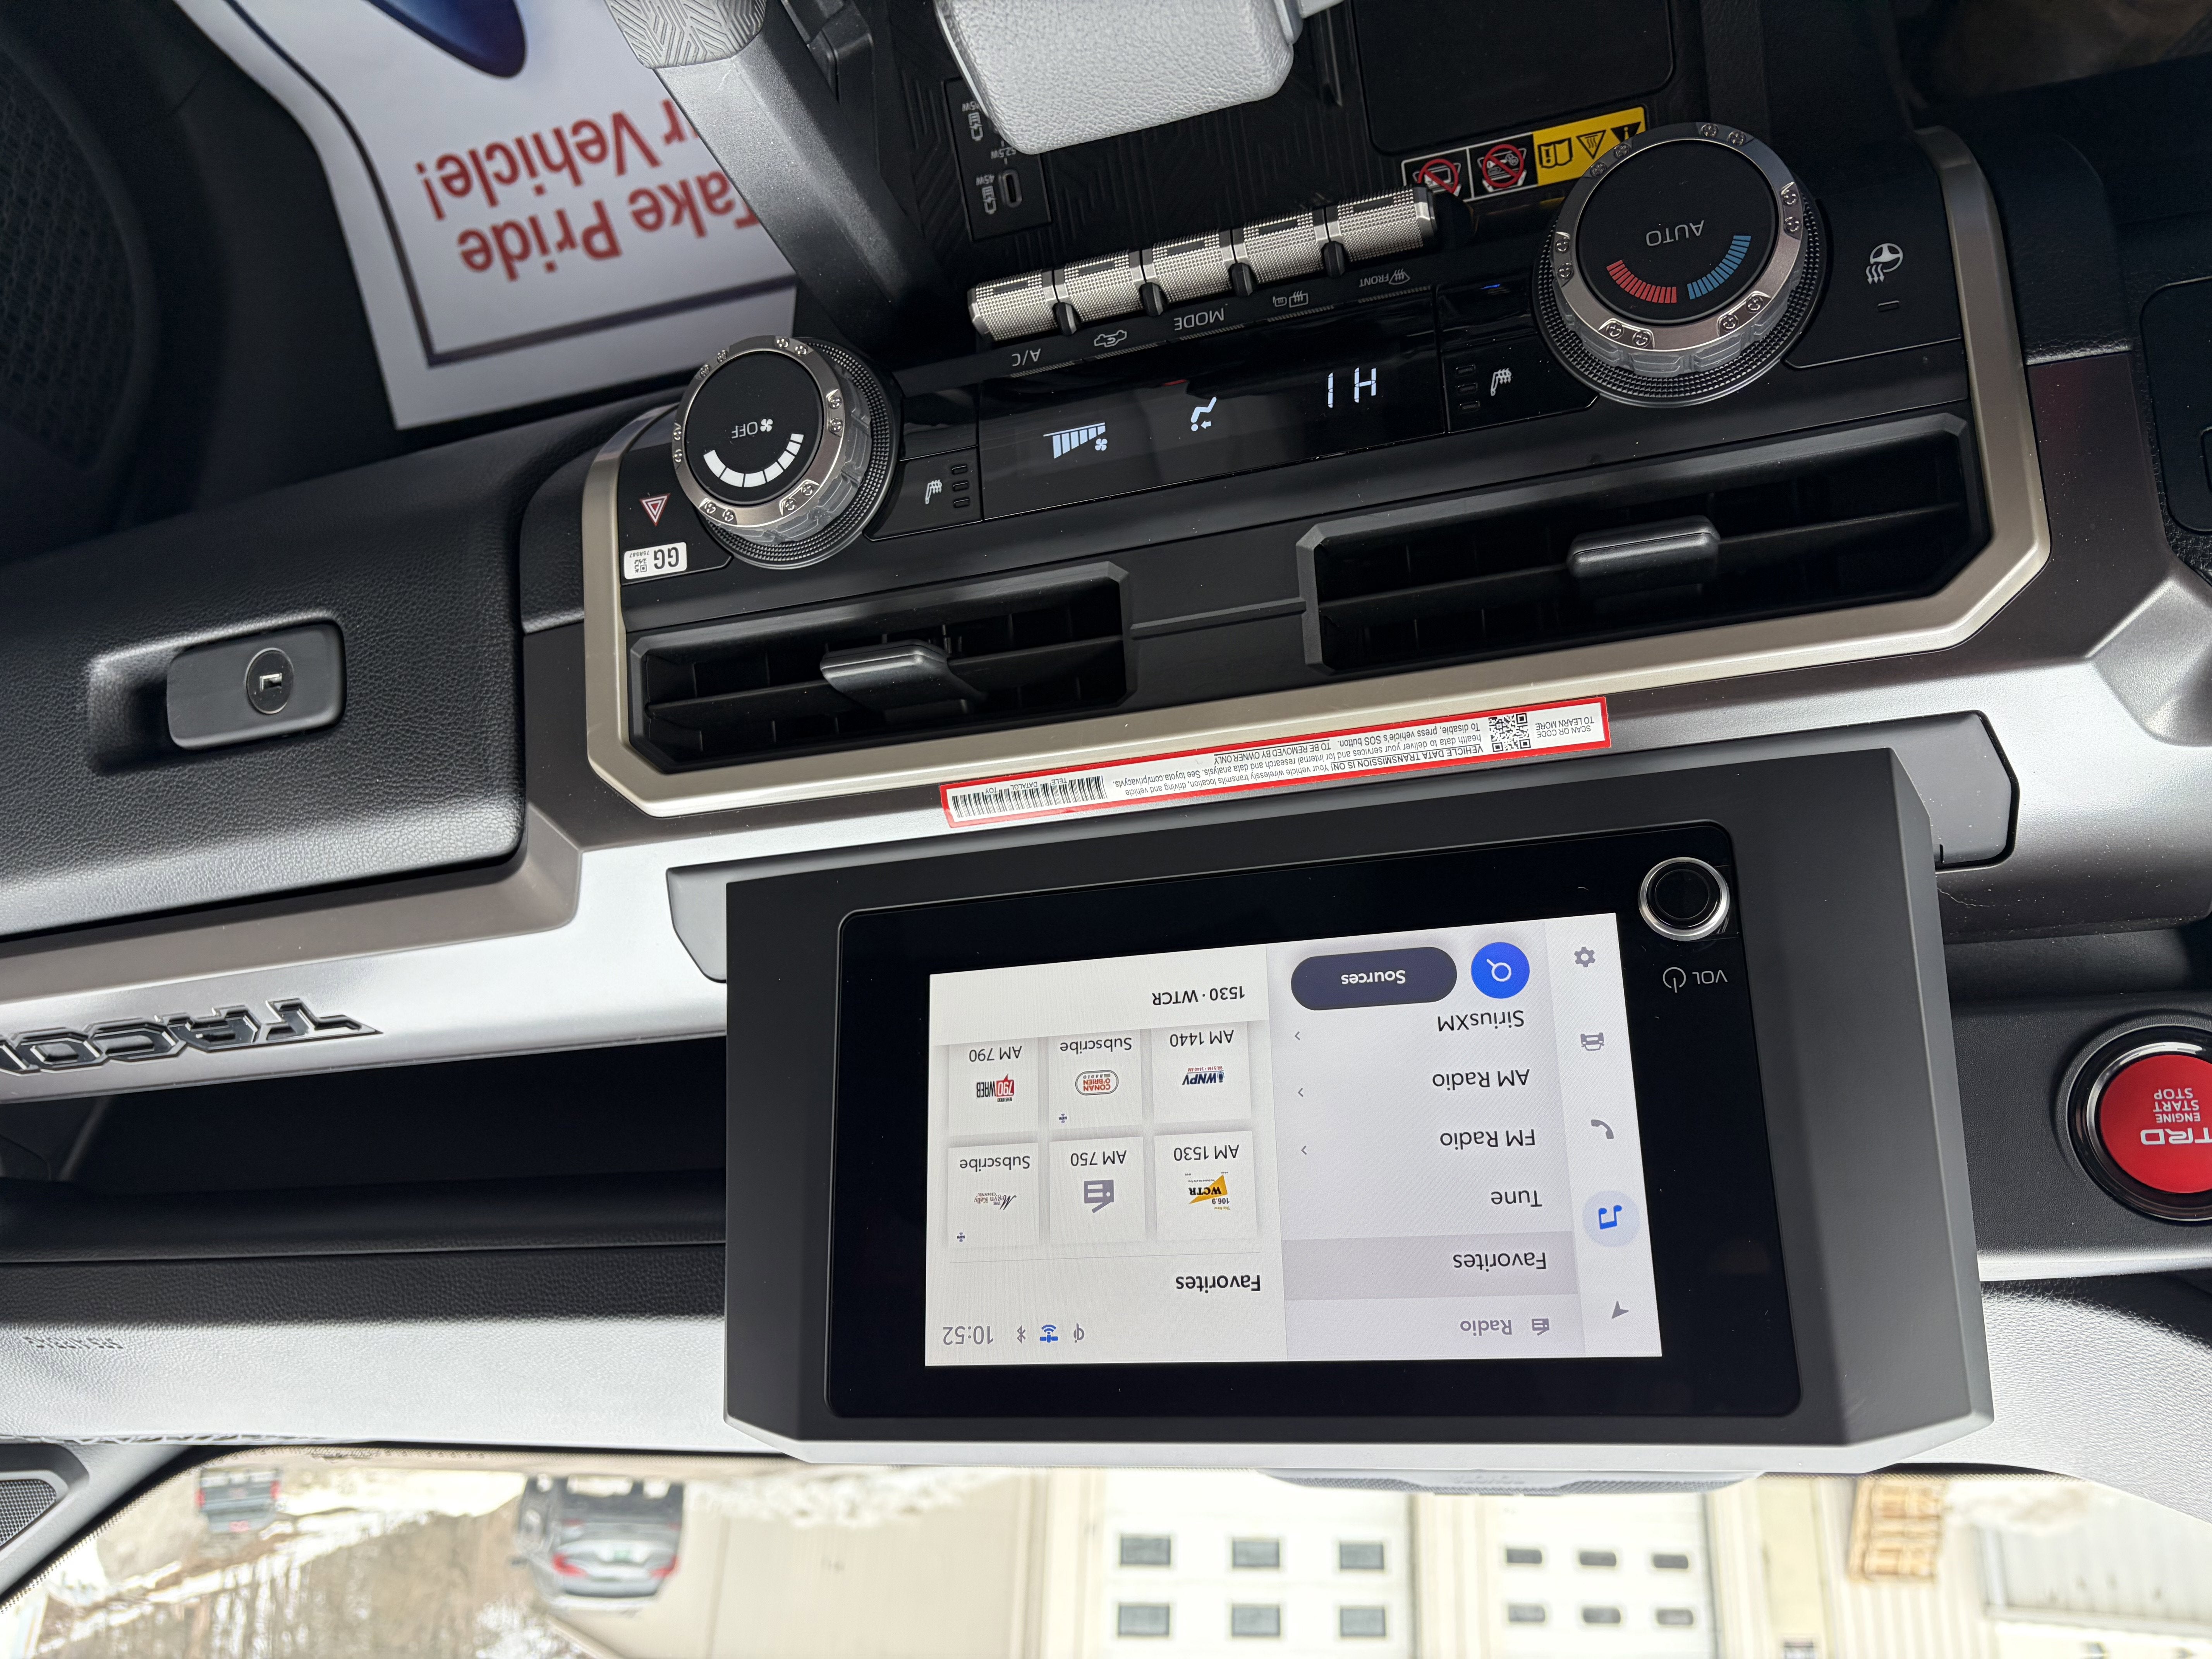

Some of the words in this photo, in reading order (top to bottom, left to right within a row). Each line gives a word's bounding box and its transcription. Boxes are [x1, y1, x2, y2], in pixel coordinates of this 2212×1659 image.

[415, 111, 661, 222] Vehicle!
[976, 174, 994, 185] 45W
[1646, 220, 1704, 246] AUTO
[457, 201, 622, 282] Pride
[1359, 275, 1389, 288] FRONT
[1173, 308, 1224, 330] MODE
[1012, 348, 1041, 367] A/C
[1328, 367, 1377, 408] HI
[732, 421, 758, 438] OFF
[654, 547, 679, 569] GG
[1535, 721, 1557, 729] MORE
[1558, 718, 1582, 727] LEARN
[1583, 716, 1594, 725] TO
[1417, 725, 1437, 736] press
[1440, 724, 1468, 735] disable,
[1471, 723, 1480, 731] To
[1383, 731, 1415, 742] vehicle's
[1458, 734, 1481, 745] health
[1536, 730, 1557, 738] CODE
[1338, 738, 1362, 747] button.
[1364, 736, 1381, 745] SOS
[1439, 737, 1455, 747] data
[1273, 745, 1307, 756] REMOVED
[1309, 744, 1319, 752] BE
[1353, 747, 1382, 757] services
[1385, 742, 1400, 752] your
[1403, 742, 1427, 752] deliver
[1446, 746, 1483, 757] VEHICLE
[1214, 755, 1232, 765] ONLY
[1233, 752, 1260, 762] OWNER
[1262, 750, 1271, 758] BY
[1297, 754, 1324, 764] internal
[1326, 753, 1335, 761] for
[1338, 751, 1350, 760] and
[1421, 750, 1444, 760] DATA
[1265, 758, 1295, 769] research
[1357, 754, 1420, 767] TRANSMISSION
[1202, 764, 1231, 776] analysis.
[1234, 764, 1249, 773] data
[1250, 763, 1263, 771] and
[1286, 766, 1310, 776] vehicle
[1313, 764, 1329, 773] Your
[1113, 771, 1185, 788] toyota.com/privacyvts.
[1218, 774, 1249, 784] transmits
[1251, 769, 1284, 781] wirelessly
[1010, 781, 1038, 790] DATALGL
[1164, 781, 1186, 791] driving
[1188, 779, 1216, 788] location,
[1125, 787, 1148, 797] vehicle
[1150, 786, 1162, 794] and
[1341, 970, 1406, 986] Sources
[1692, 970, 1727, 984] VOL
[1152, 989, 1198, 1005] WTCR
[1209, 985, 1245, 1001] 1530
[1437, 1010, 1525, 1031] SiriusXM
[0, 1004, 361, 1074] TACO
[1170, 1032, 1204, 1047] 1440
[1208, 1029, 1234, 1044] AM
[1060, 1037, 1132, 1054] Subscribe
[969, 1047, 995, 1062] 790
[998, 1046, 1022, 1059] AM
[1182, 1073, 1216, 1085] WNPV
[1432, 1072, 1490, 1090] Radio
[1497, 1068, 1530, 1087] AM
[976, 1081, 996, 1097] WAEB
[997, 1081, 1013, 1096] 790
[2154, 1088, 2193, 1099] STOP
[2153, 1100, 2199, 1112] START
[2155, 1112, 2200, 1123] ENGINE
[1439, 1131, 1498, 1150] Radio
[1505, 1129, 1535, 1146] FM
[2140, 1127, 2212, 1145] TRD
[1102, 1150, 1127, 1164] AM
[1173, 1146, 1209, 1161] 1530
[1213, 1144, 1239, 1158] AM
[960, 1155, 1030, 1171] Subscribe
[1070, 1151, 1097, 1166] 750
[1188, 1187, 1221, 1195] WCTR
[990, 1195, 1017, 1210] Megyn
[1490, 1190, 1542, 1207] Tune
[1453, 1252, 1547, 1272] Favorites
[1175, 1274, 1261, 1293] Favorites
[1460, 1319, 1512, 1336] Radio
[942, 1325, 993, 1345] 10:52
